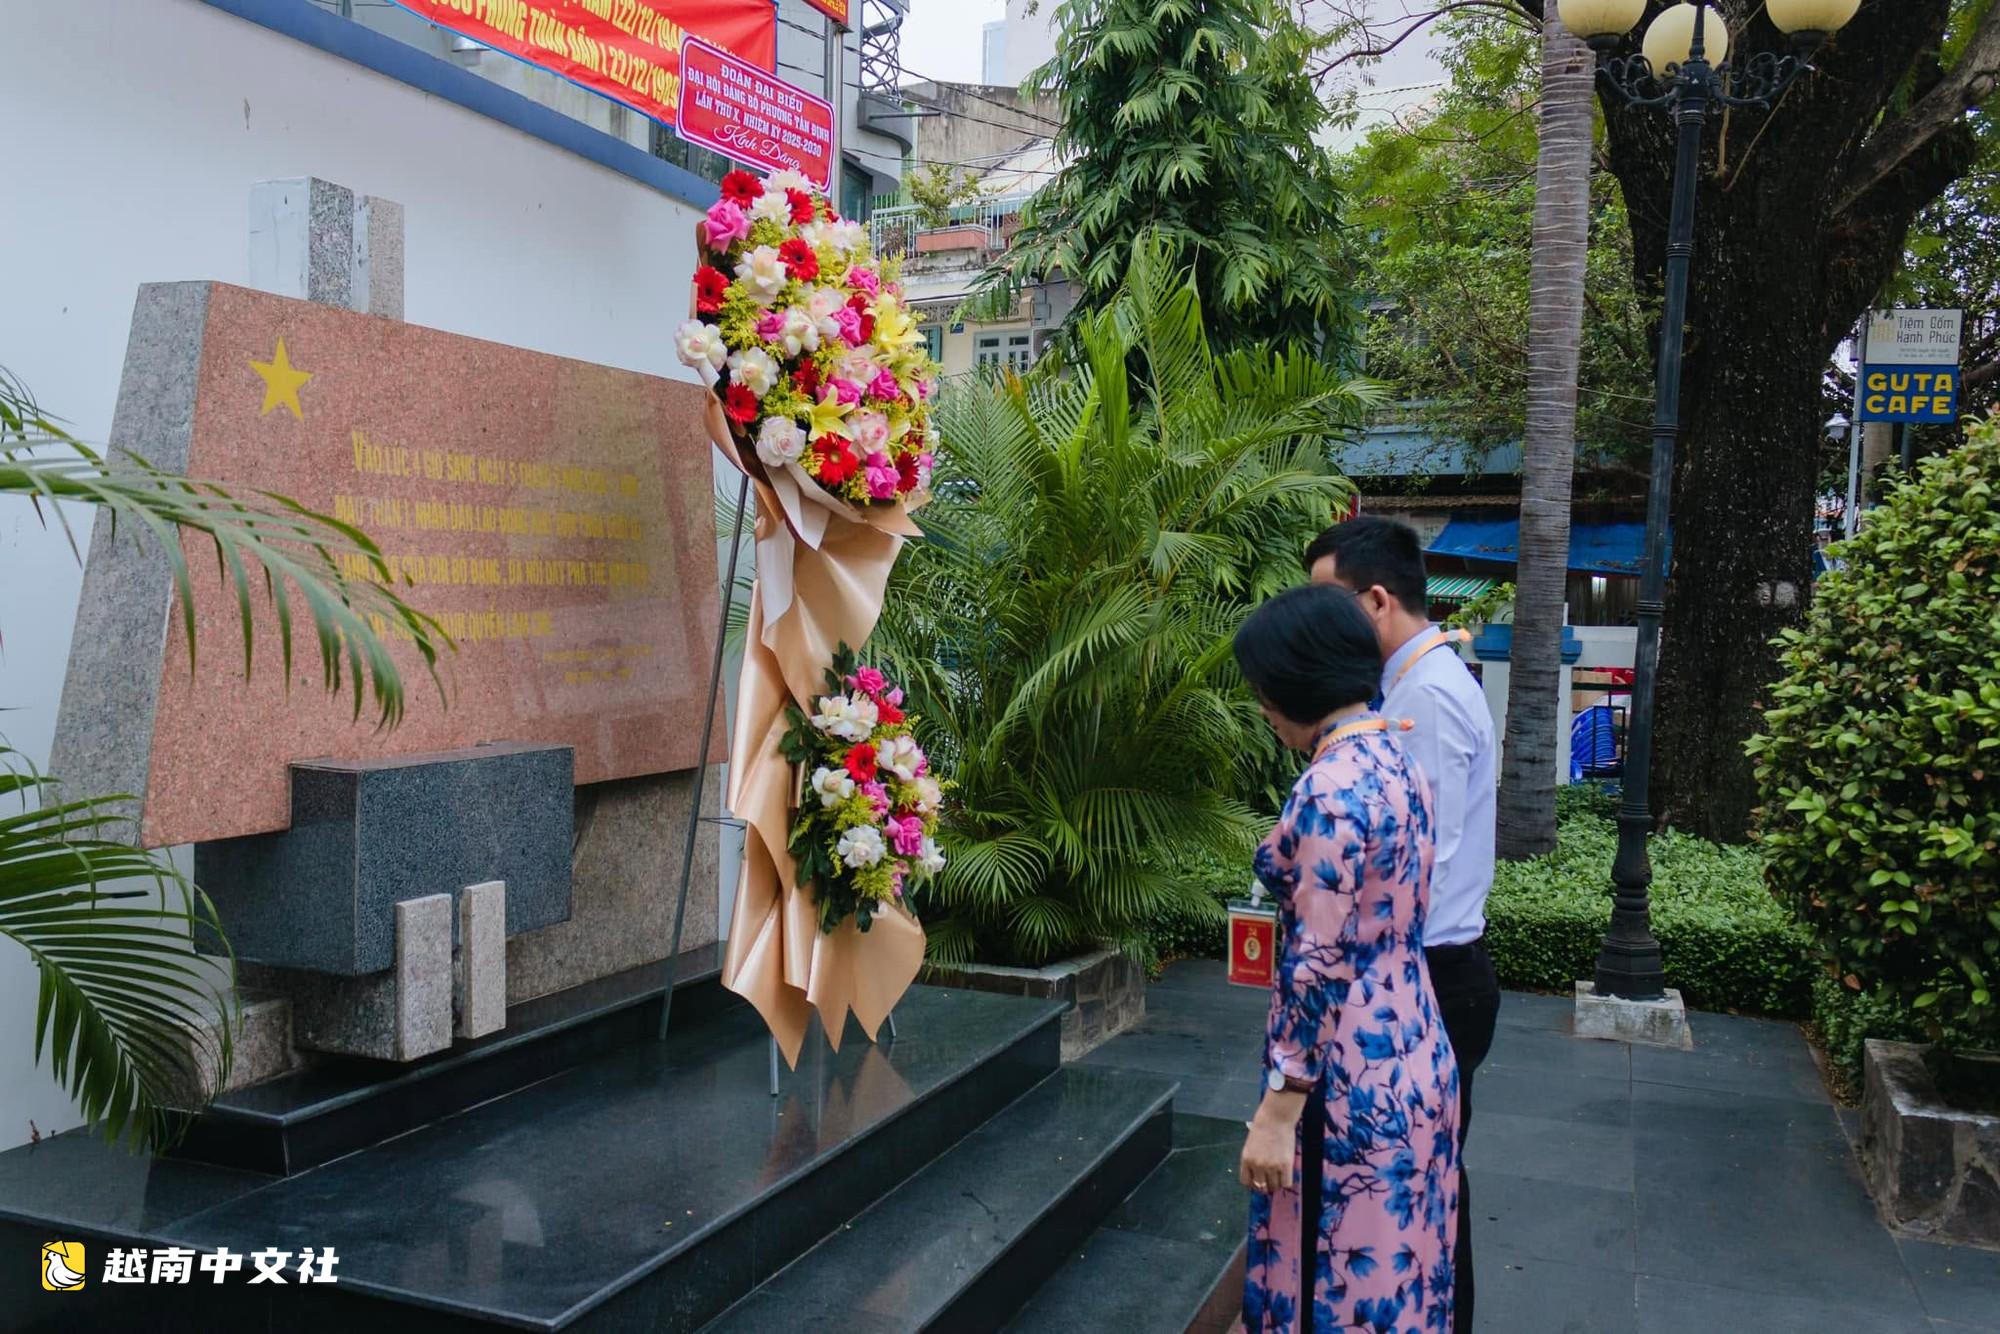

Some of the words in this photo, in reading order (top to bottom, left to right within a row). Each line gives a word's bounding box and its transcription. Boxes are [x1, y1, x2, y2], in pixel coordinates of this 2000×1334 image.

[529, 7, 569, 58] TOÀN
[567, 25, 600, 73] DÂN
[721, 64, 752, 89] ĐOÀN
[755, 80, 775, 101] ĐẠI
[777, 91, 804, 113] BIỂU
[688, 67, 704, 87] ĐẠI
[706, 75, 721, 95] HỘI
[723, 83, 746, 106] ĐẢNG
[747, 94, 759, 112] BỘ
[794, 115, 810, 134] TÂN
[811, 122, 831, 143] ĐỊNH
[714, 124, 758, 150] Kính
[743, 111, 770, 135] NHIỆM
[781, 129, 823, 157] 2025-2030
[1899, 316, 1924, 331] Tiệm
[1897, 331, 1923, 346] Hạnh
[1929, 330, 1956, 344] Phúc
[1867, 373, 1953, 392] GUTA
[1865, 395, 1952, 414] CAFE
